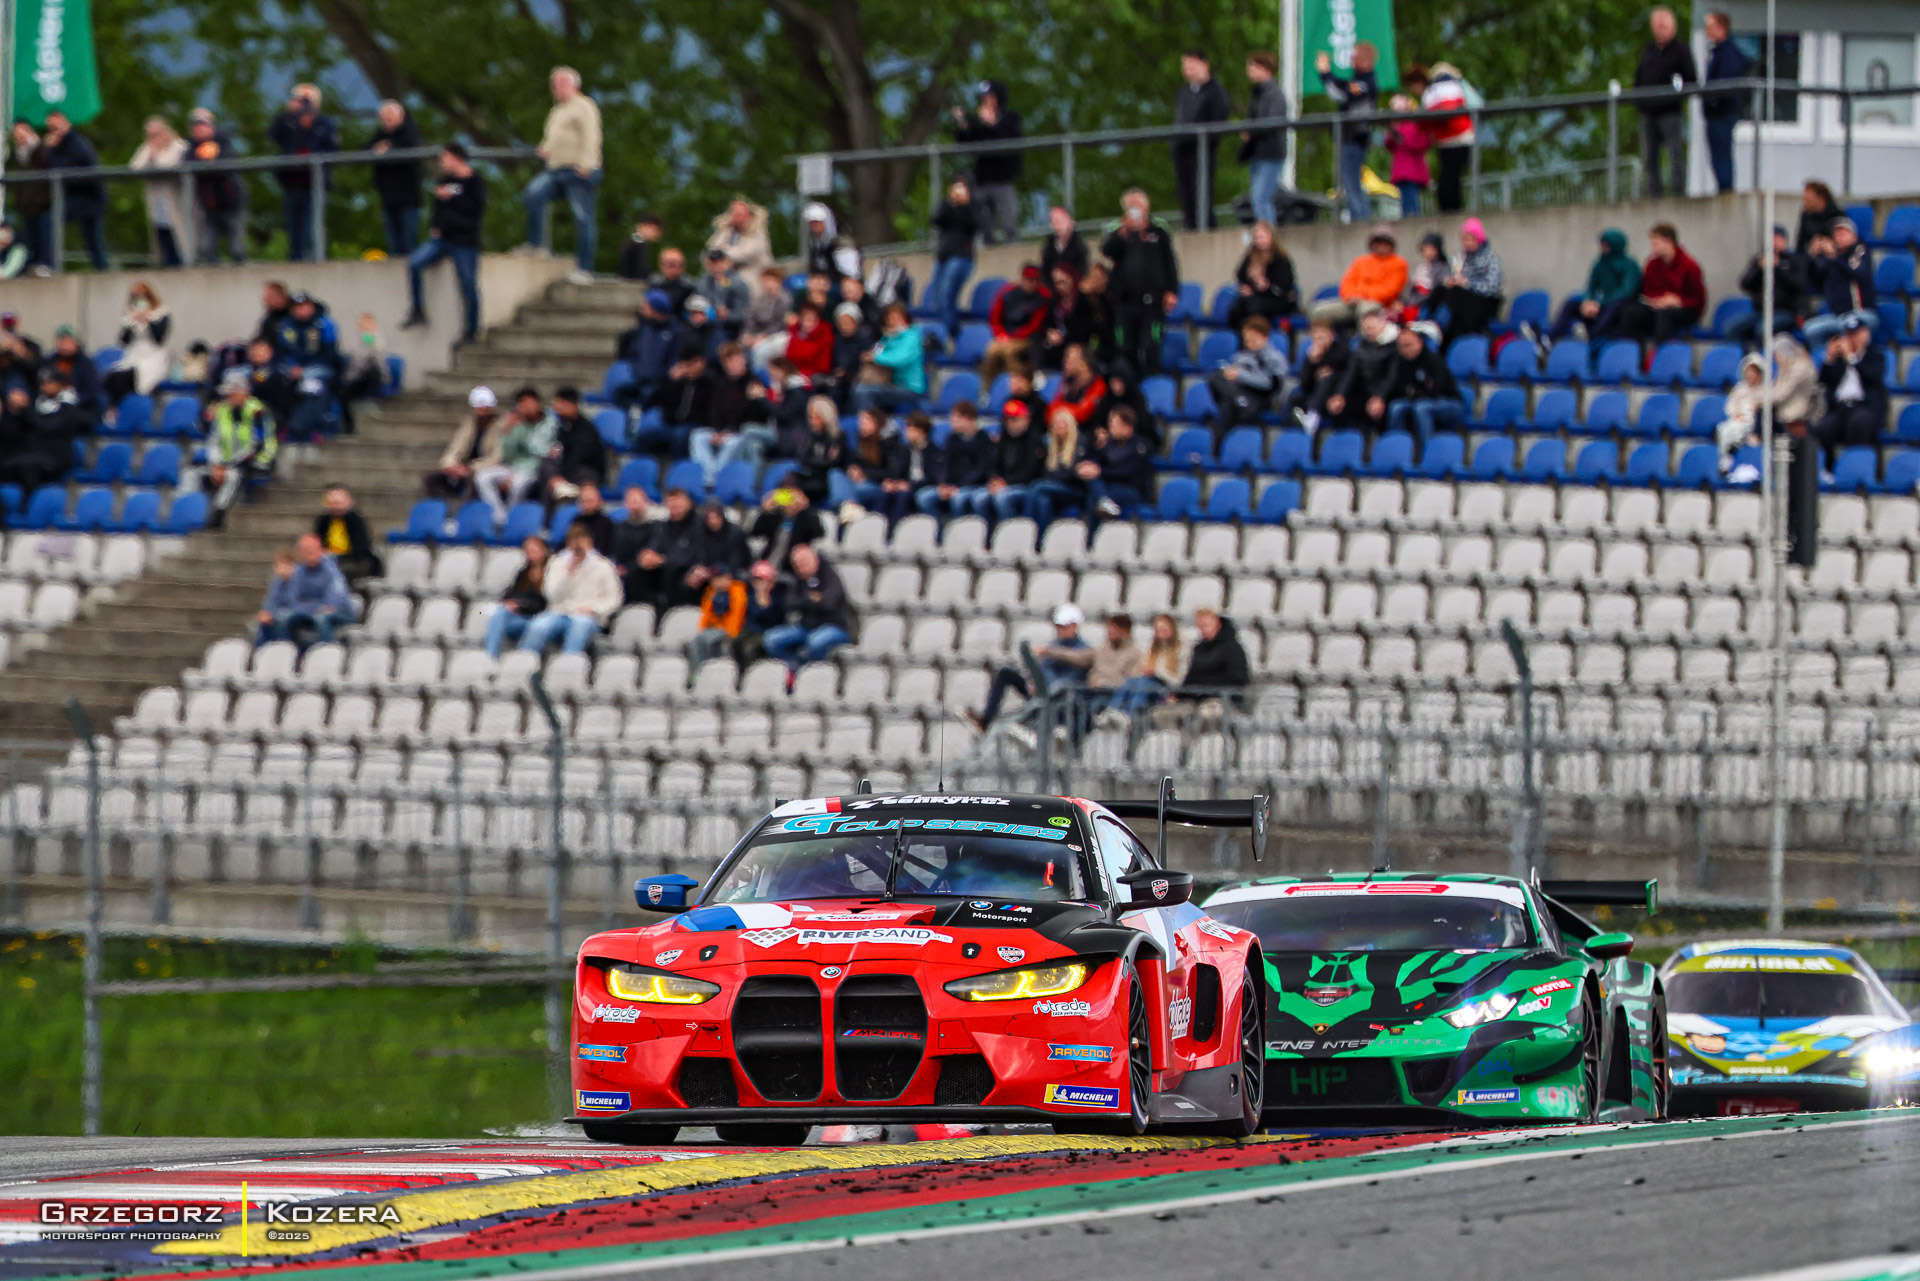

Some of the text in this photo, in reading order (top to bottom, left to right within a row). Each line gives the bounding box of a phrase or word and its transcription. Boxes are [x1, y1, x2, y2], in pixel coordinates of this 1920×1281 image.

[783, 813, 1068, 840] GT CUP SERIES
[972, 912, 1028, 922] Motorsport
[1533, 981, 1572, 996] MOTUL
[1322, 1038, 1449, 1050] INTERNATIONAL
[580, 1047, 622, 1059] RAVENOL
[1055, 1048, 1109, 1058] RAVENOL
[1291, 1067, 1346, 1095] HP
[586, 1097, 623, 1105] MICHELIN
[1070, 1092, 1113, 1102] MICHELIN
[1476, 1092, 1515, 1100] MICHELIN
